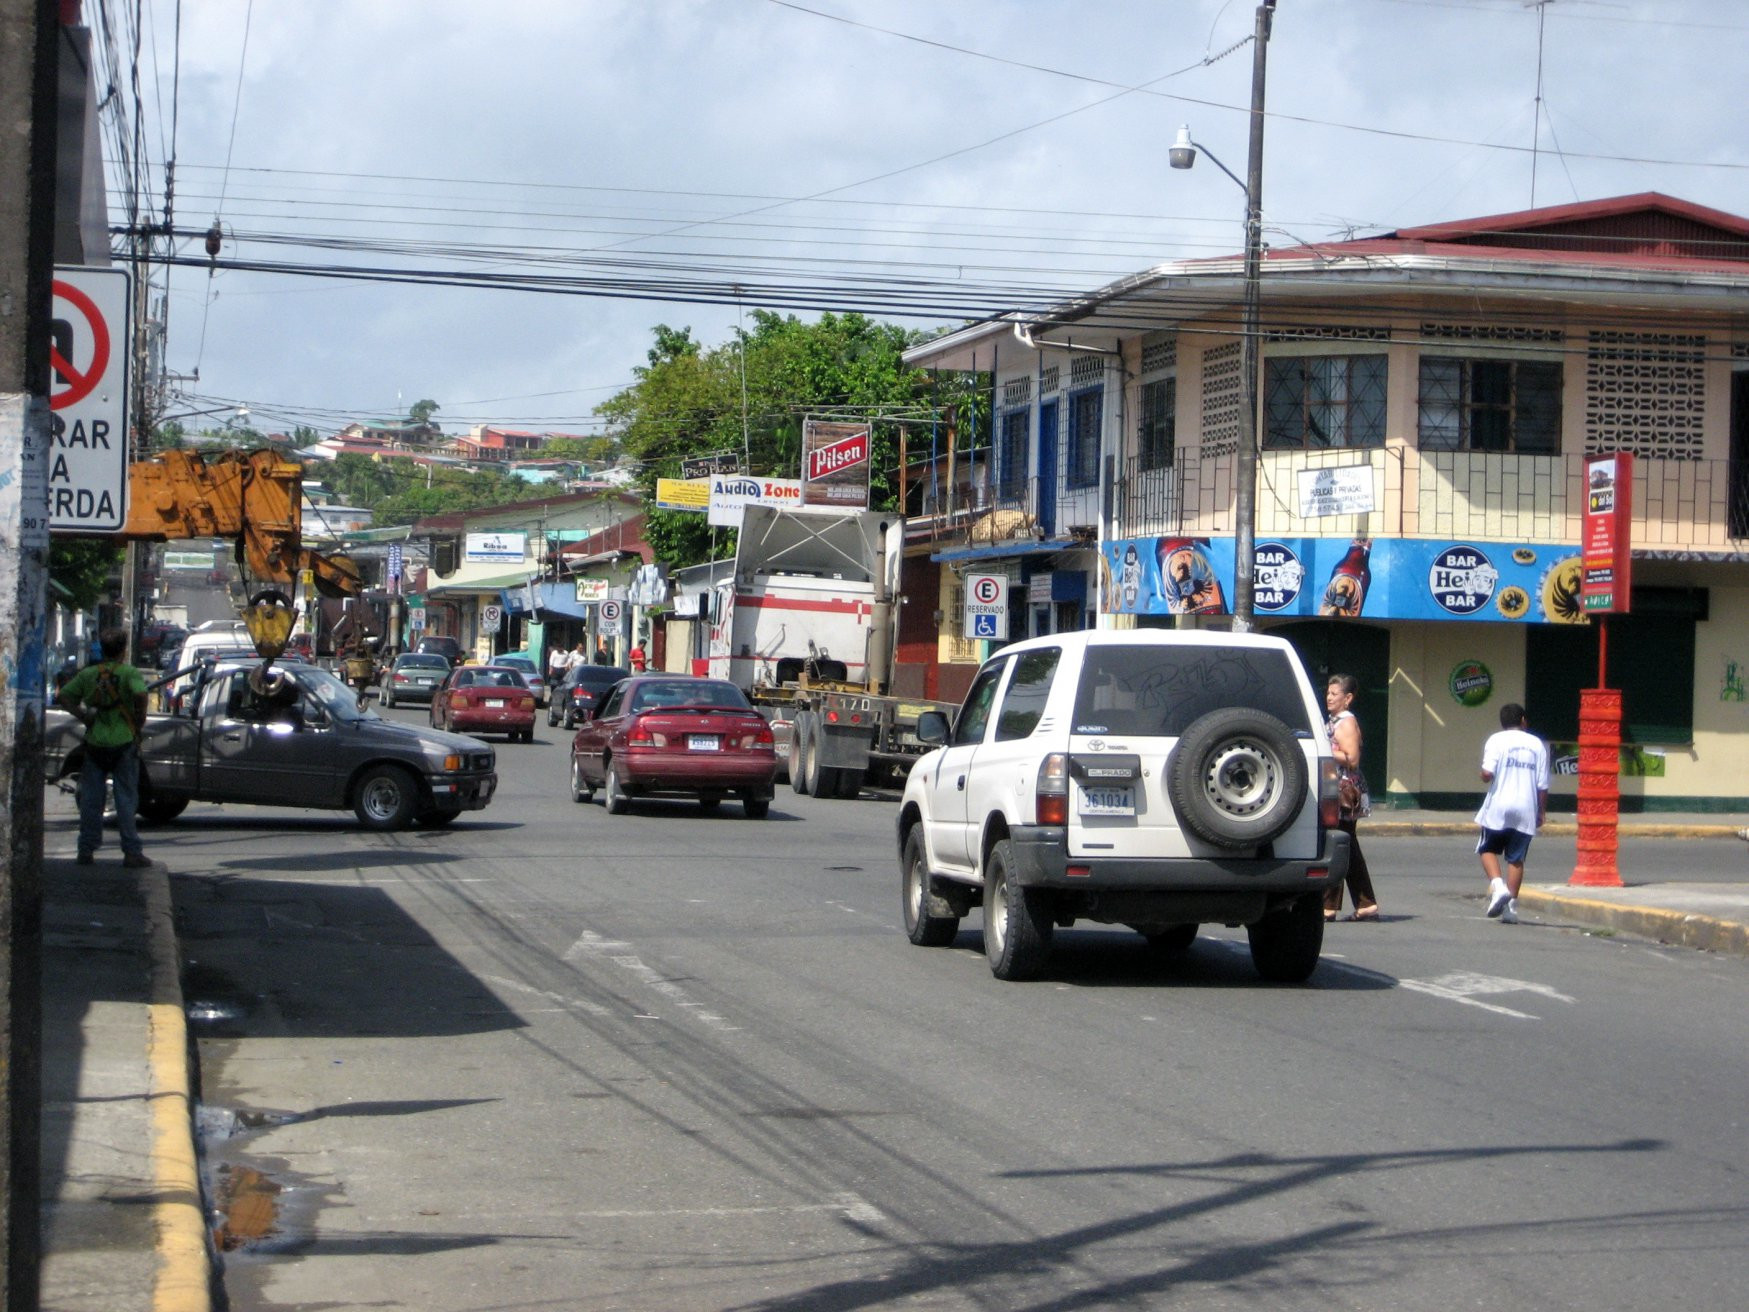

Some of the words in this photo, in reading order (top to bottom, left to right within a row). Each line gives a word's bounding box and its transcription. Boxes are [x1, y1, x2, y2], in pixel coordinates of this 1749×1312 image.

[816, 446, 861, 474] Pilsen
[685, 467, 708, 477] PRO
[714, 481, 757, 496] Audio
[764, 482, 800, 498] Zone
[1257, 552, 1285, 564] BAR
[1446, 555, 1477, 567] BAR
[1436, 571, 1470, 587] Hei
[982, 583, 991, 598] E
[1255, 591, 1284, 603] BAR
[1445, 595, 1476, 606] BAR
[606, 605, 614, 616] E
[967, 604, 1005, 614] RESERVADO
